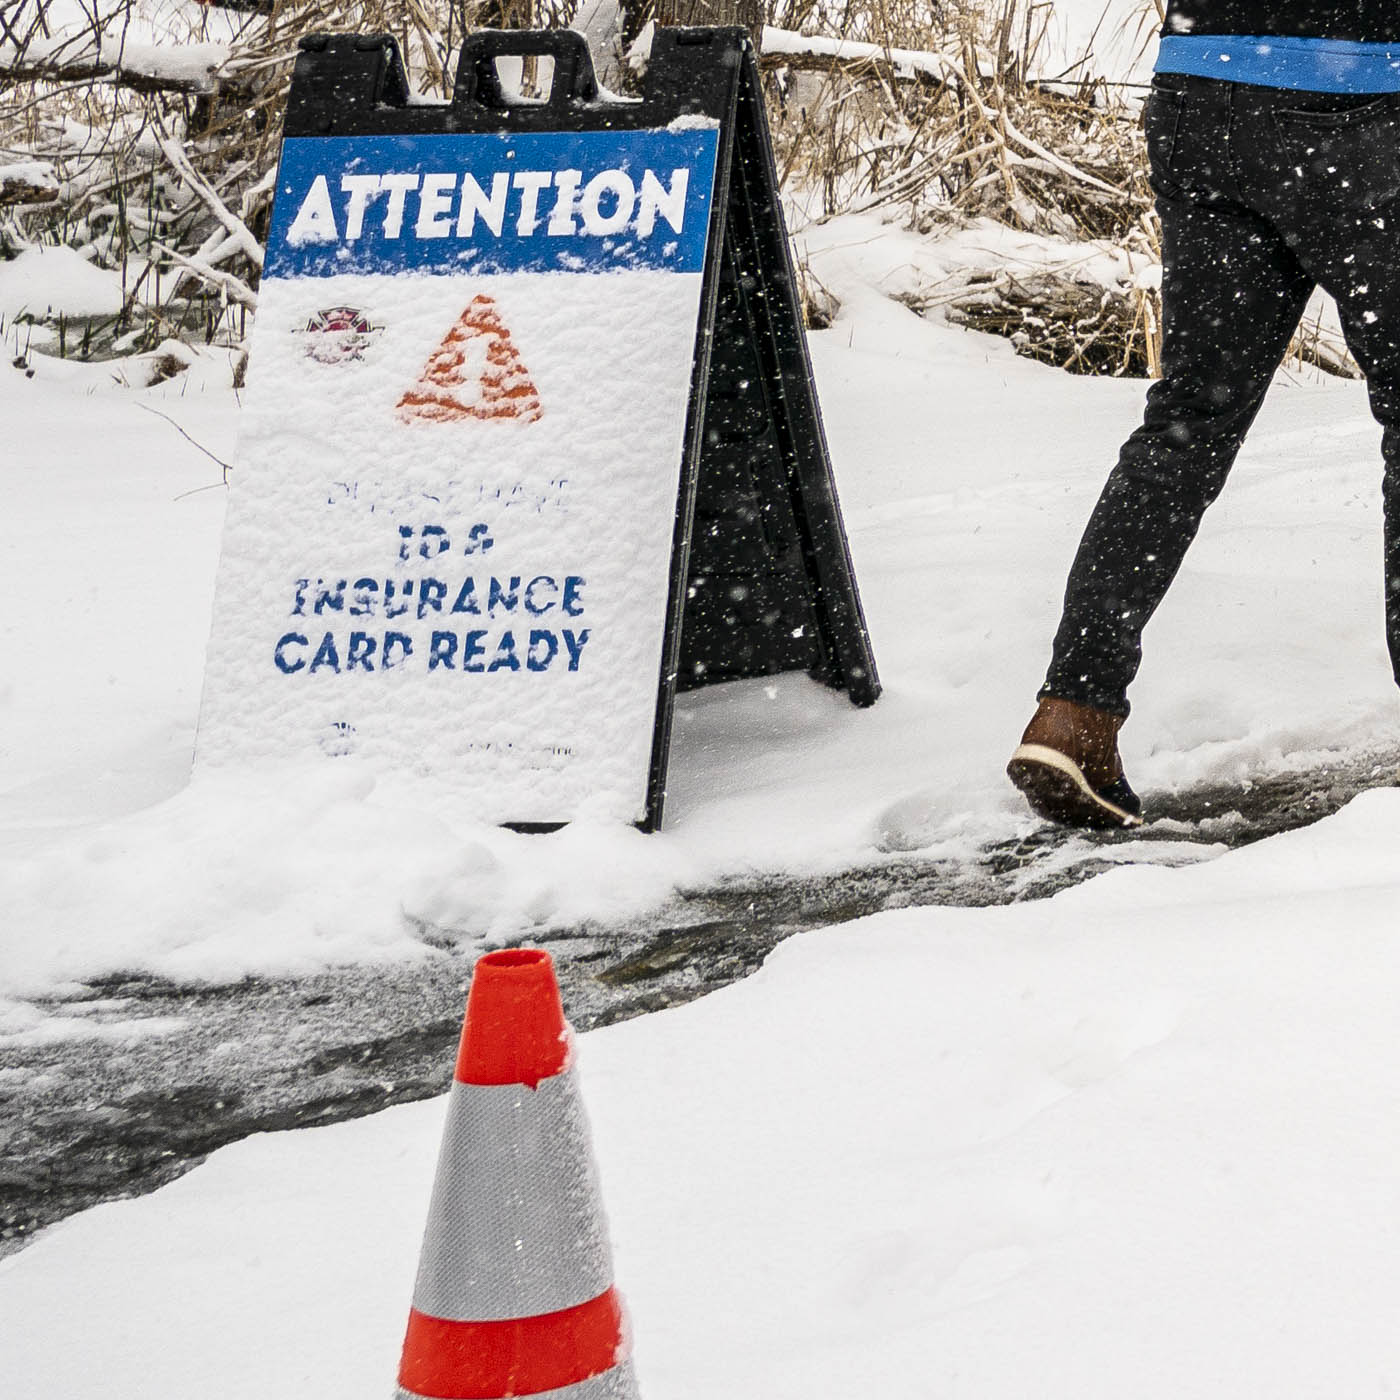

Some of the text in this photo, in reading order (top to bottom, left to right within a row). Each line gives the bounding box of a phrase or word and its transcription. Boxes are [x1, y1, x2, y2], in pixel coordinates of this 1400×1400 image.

[286, 168, 690, 243] ATTENTION
[399, 525, 450, 560] ID
[291, 575, 587, 619] INSURANCE
[274, 629, 592, 675] CARD READY
